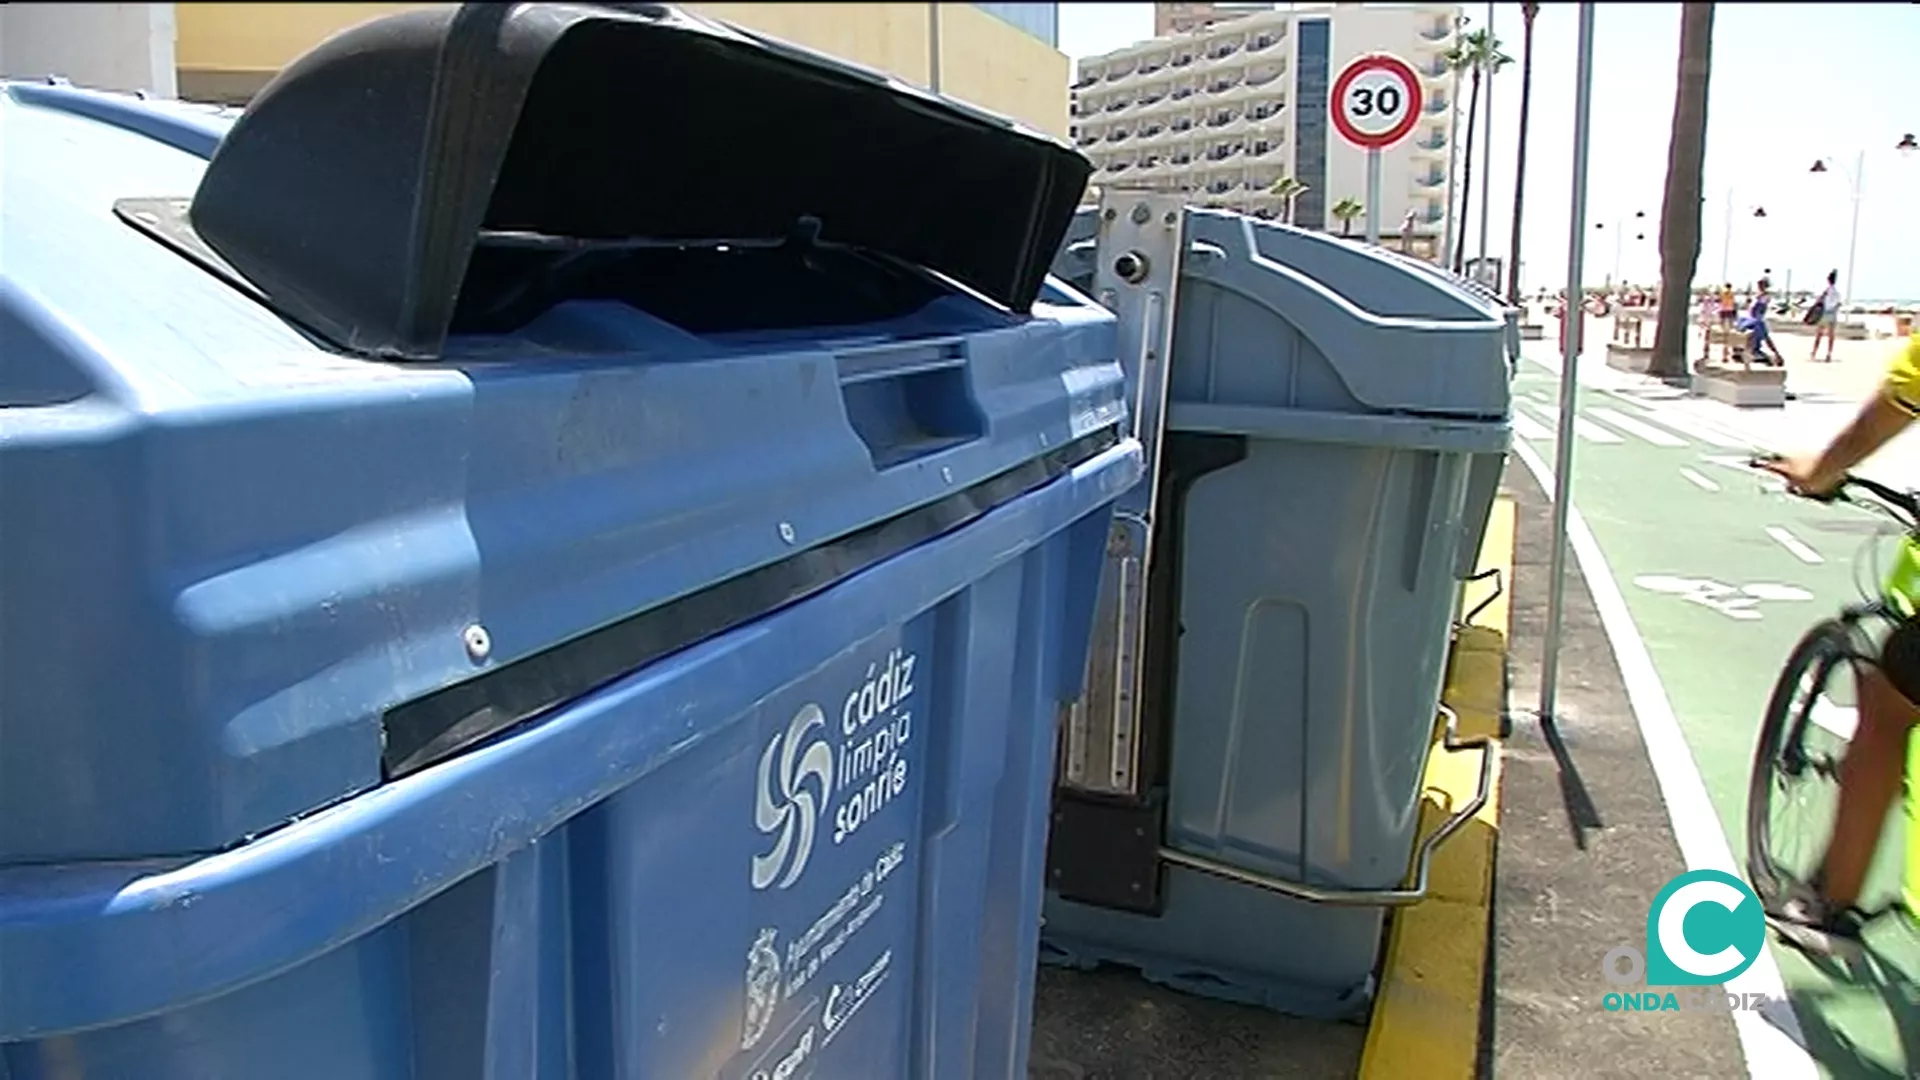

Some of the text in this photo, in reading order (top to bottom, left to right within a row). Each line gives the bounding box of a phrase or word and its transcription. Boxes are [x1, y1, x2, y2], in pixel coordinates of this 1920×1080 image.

[1352, 87, 1400, 116] 30
[843, 648, 915, 735] cádiz
[837, 707, 911, 791] limpia
